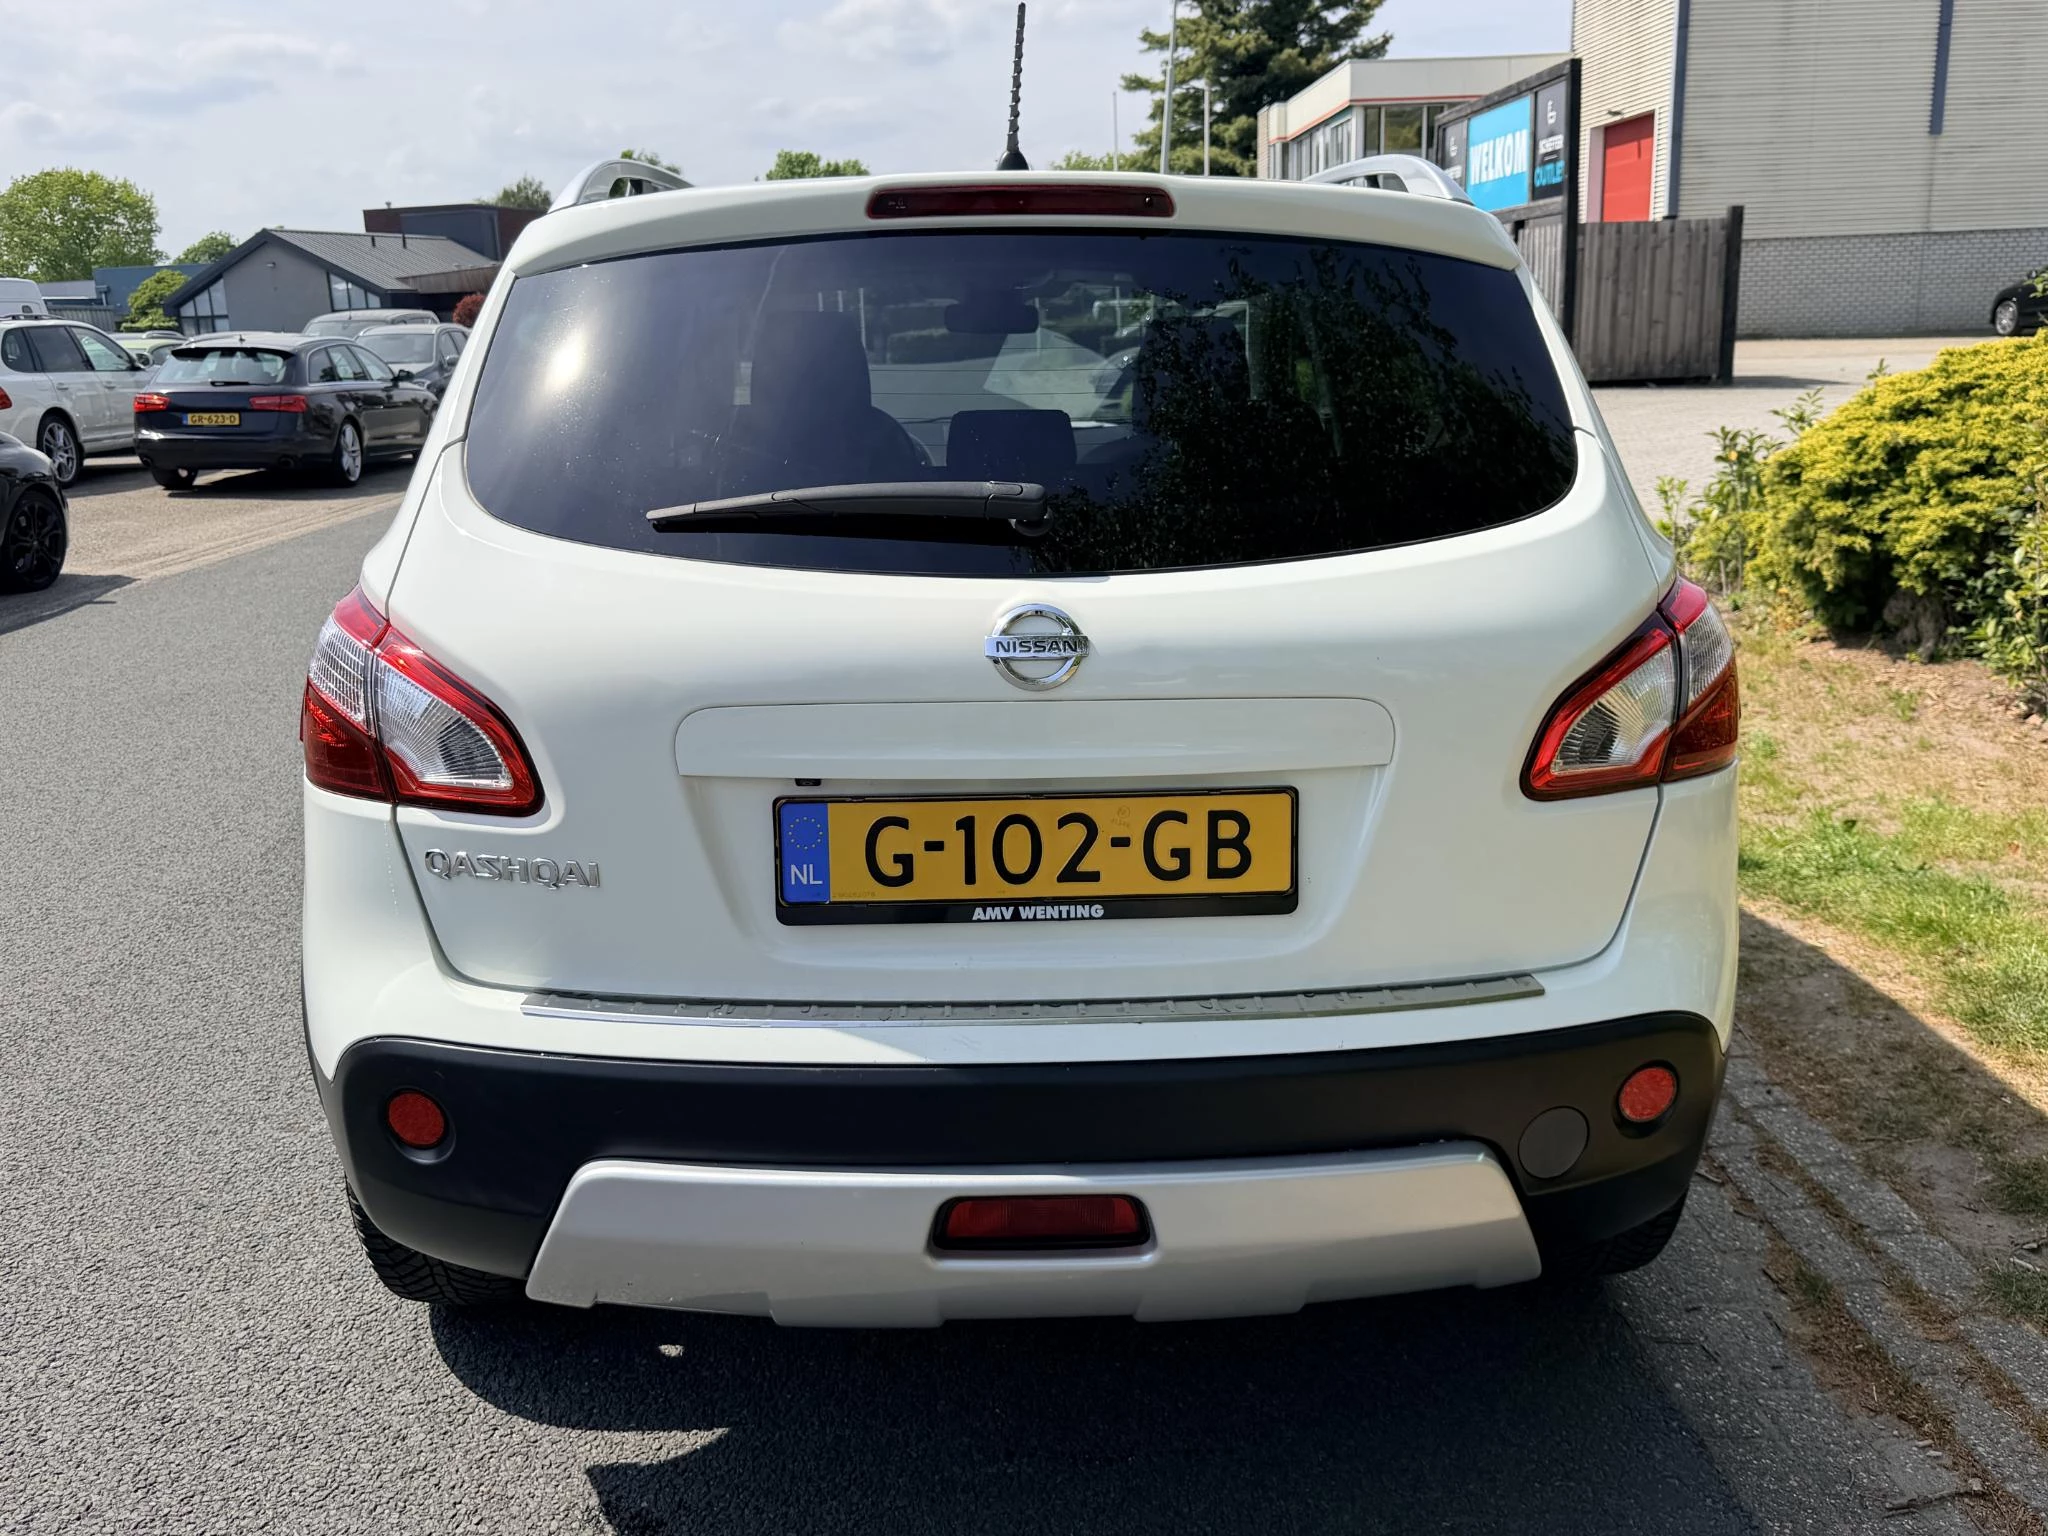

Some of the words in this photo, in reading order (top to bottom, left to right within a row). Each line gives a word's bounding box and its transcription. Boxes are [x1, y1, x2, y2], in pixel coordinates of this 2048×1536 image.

[1469, 128, 1528, 186] WELKOM
[190, 414, 237, 424] GR-623-D
[995, 640, 1078, 653] NISSAN
[865, 809, 1252, 888] G-102-GB
[425, 848, 600, 890] QASHQAI
[790, 863, 824, 886] NL
[972, 906, 1015, 921] AMV
[1018, 904, 1105, 920] WENTING
